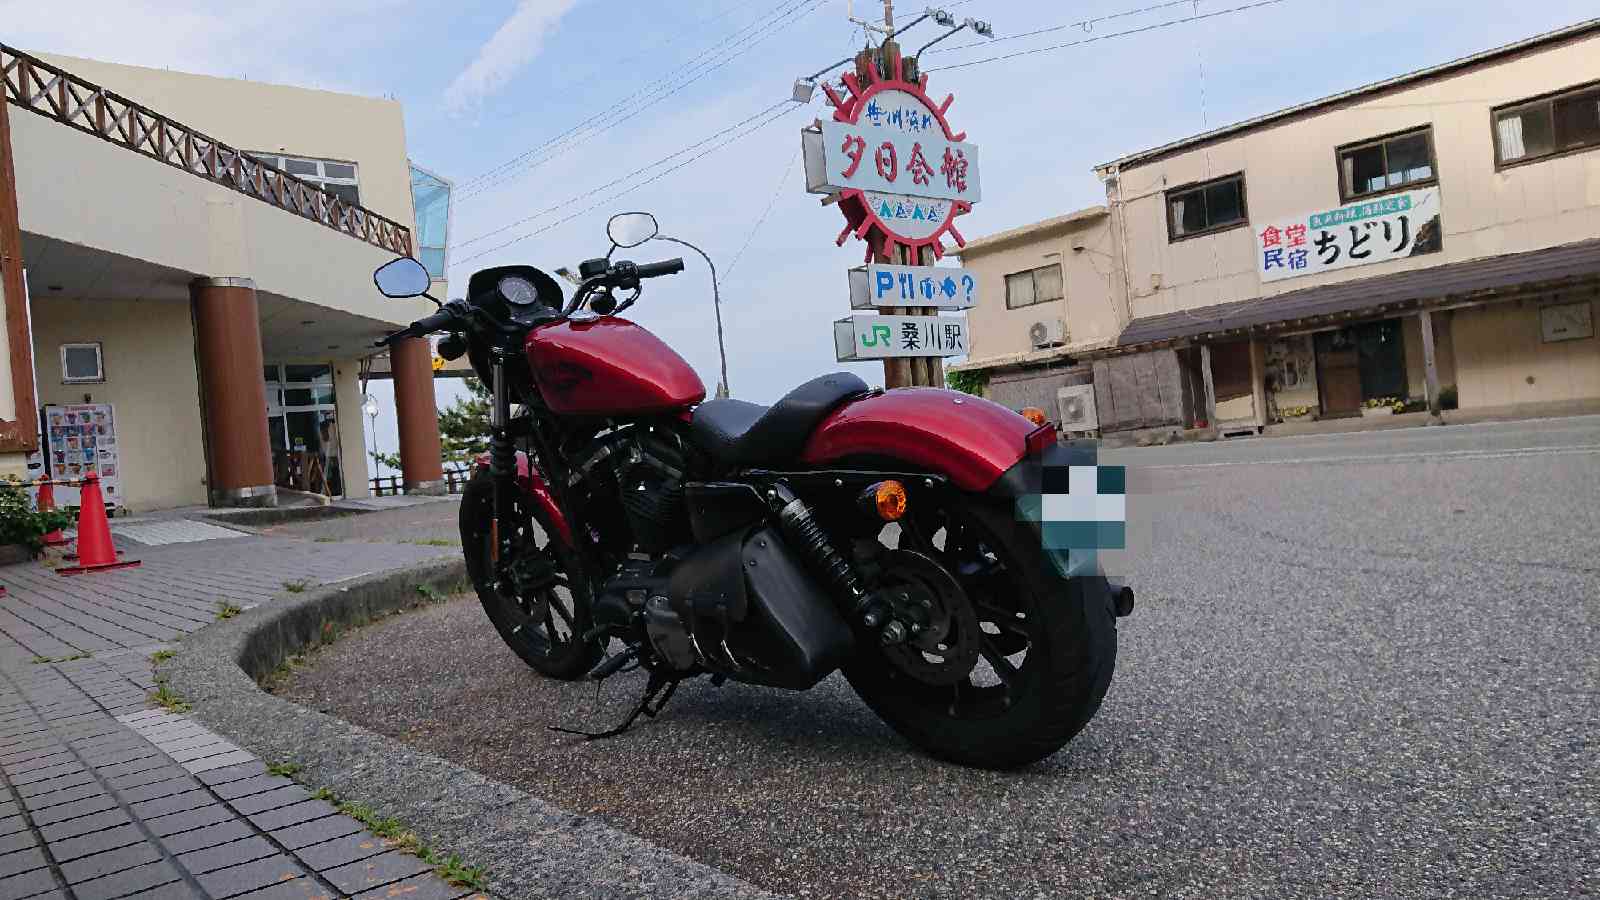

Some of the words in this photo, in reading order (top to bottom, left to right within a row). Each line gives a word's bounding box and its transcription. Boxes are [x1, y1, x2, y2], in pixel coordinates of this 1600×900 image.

[841, 134, 969, 193] 夕日会館
[1260, 223, 1307, 248] 食堂
[1314, 215, 1410, 264] ちどり
[1263, 248, 1310, 271] 民宿
[861, 325, 891, 347] JR
[901, 322, 963, 350] 桑川駅
